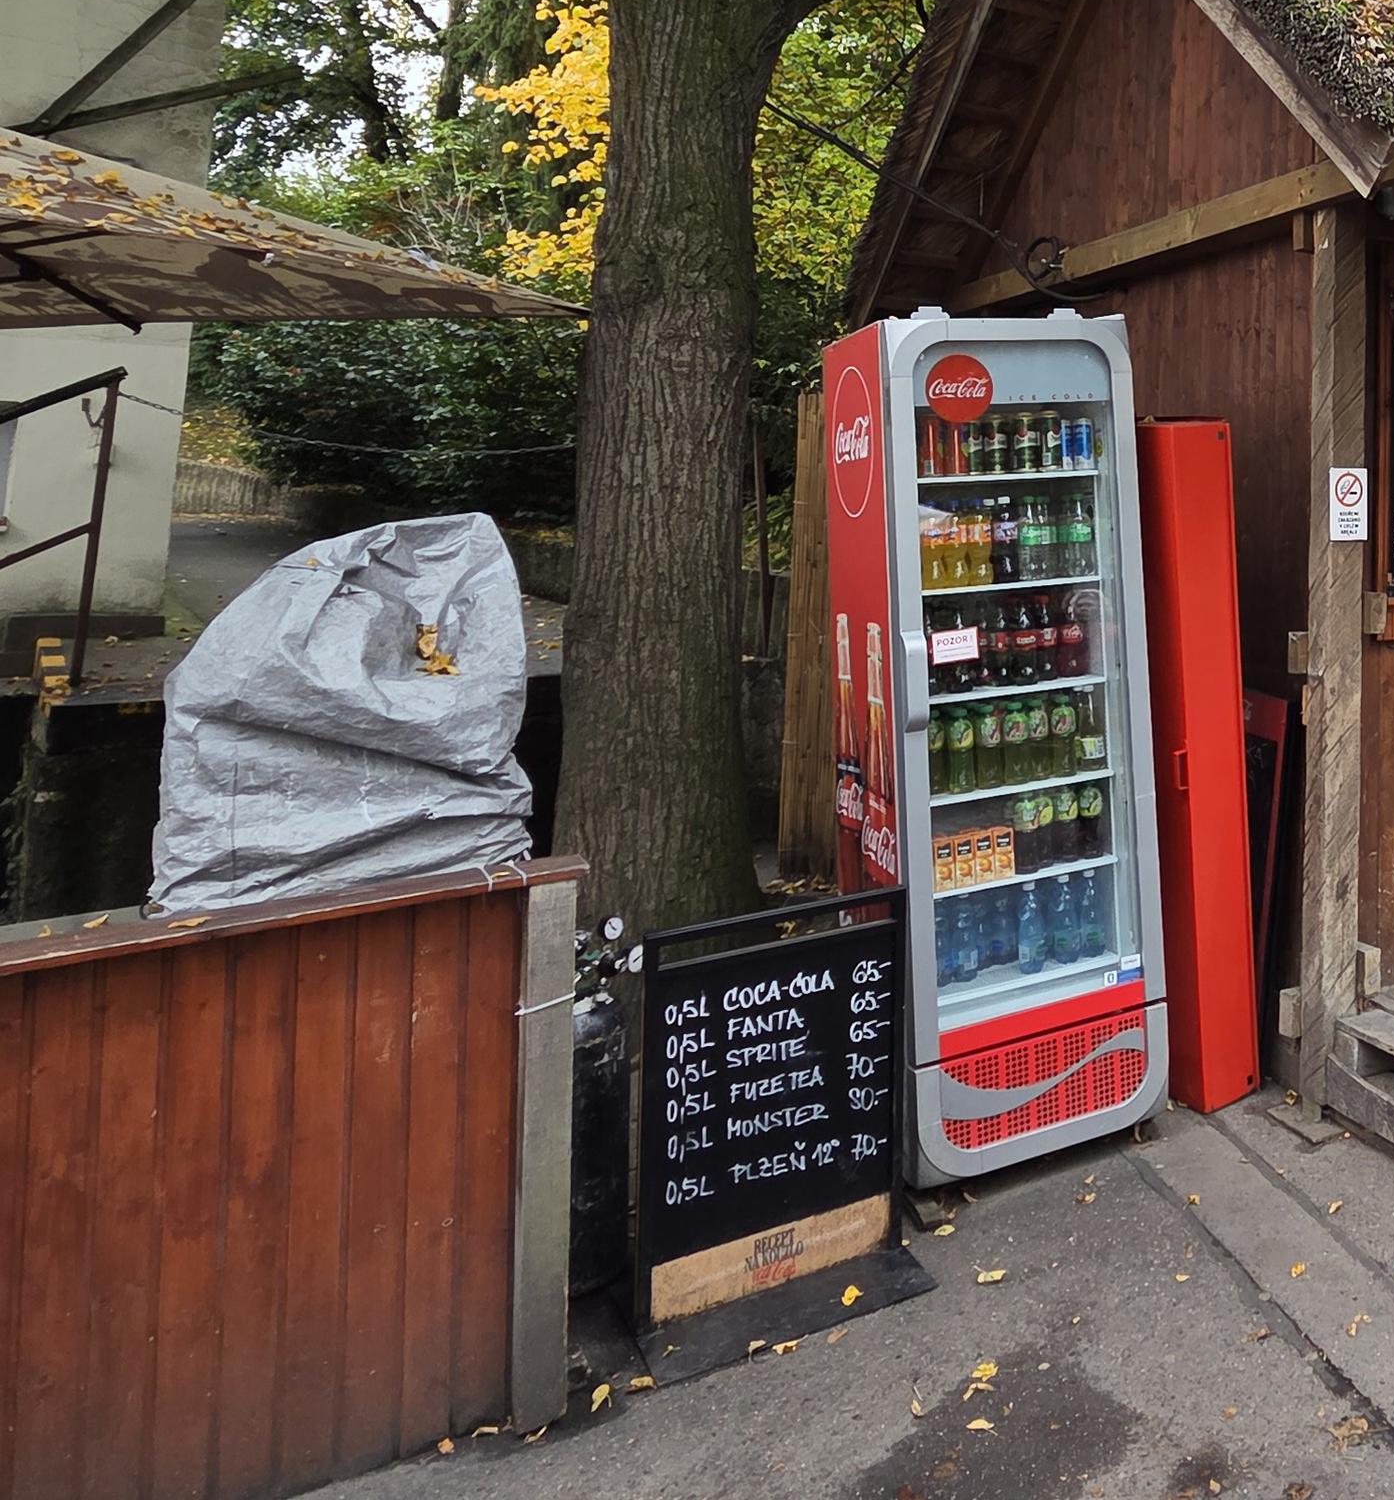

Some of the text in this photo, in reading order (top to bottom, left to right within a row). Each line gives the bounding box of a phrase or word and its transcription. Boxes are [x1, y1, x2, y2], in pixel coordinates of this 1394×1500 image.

[929, 377, 989, 399] Coca-Cola
[1008, 392, 1094, 402] ICE COLD
[836, 415, 870, 464] Coca-Cola
[665, 995, 710, 1026] 0,5L
[722, 969, 835, 1012] COCA-COLA
[666, 1028, 715, 1064] 0,5L
[727, 1007, 805, 1041] FANTA
[666, 1059, 717, 1096] 0,5L
[726, 1033, 807, 1069] SPRITE
[666, 1091, 716, 1124] 0,5L
[730, 1073, 785, 1104] FUZE
[788, 1065, 825, 1092] TEA
[667, 1126, 714, 1163] 0,5L
[726, 1103, 830, 1140] MONSTER
[665, 1175, 715, 1205] 0,5L
[728, 1140, 806, 1184] PLZEŇ
[811, 1138, 840, 1167] 12°
[754, 1227, 795, 1254] RECEPT
